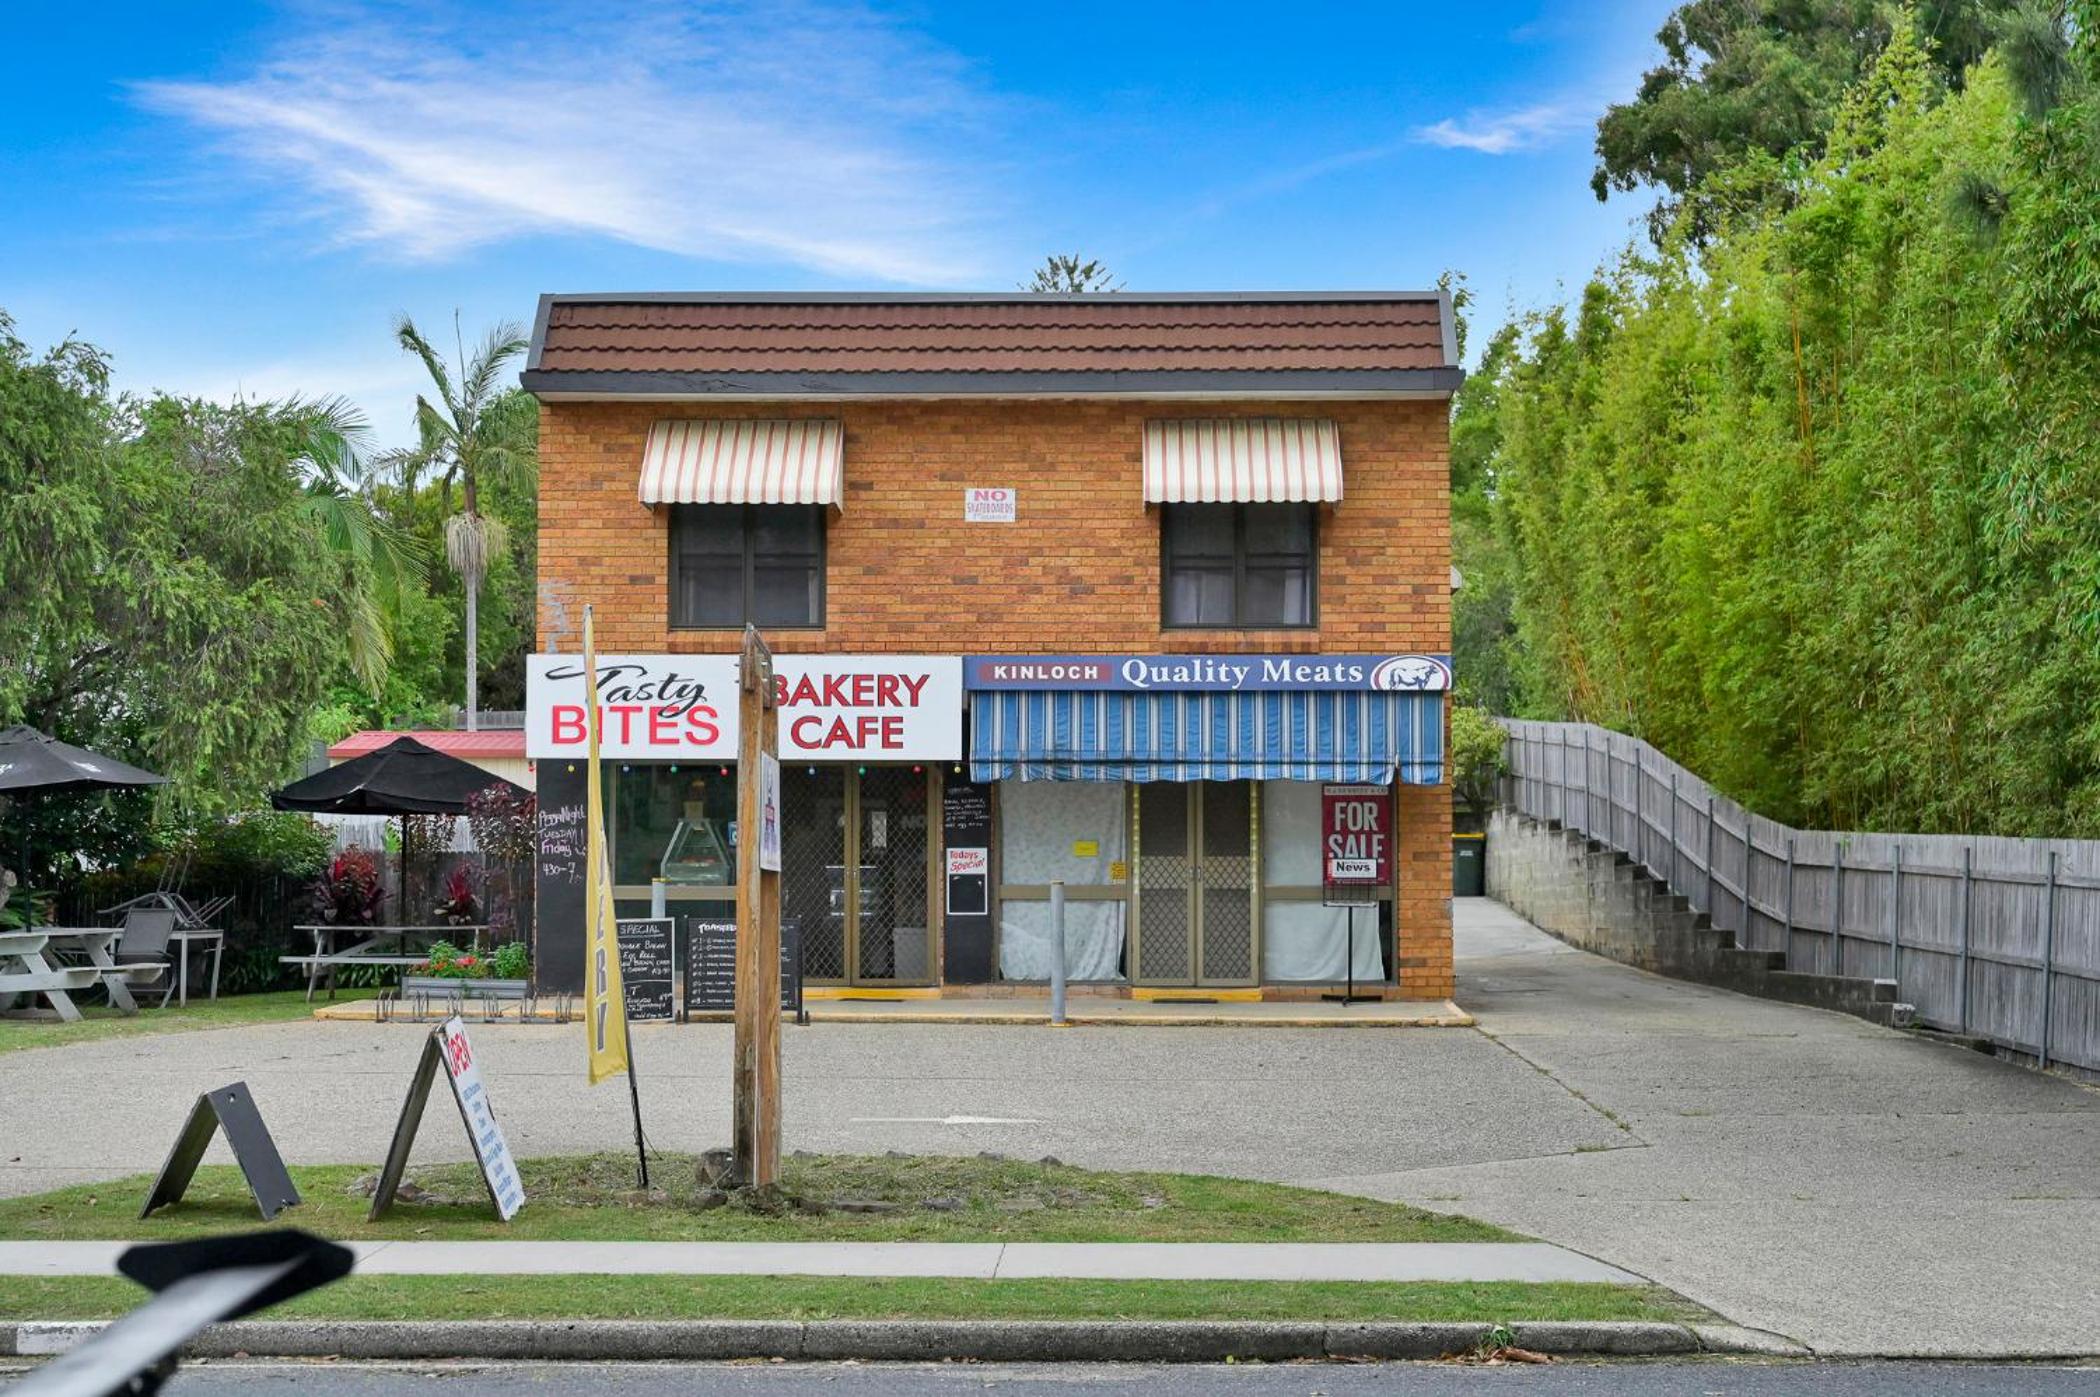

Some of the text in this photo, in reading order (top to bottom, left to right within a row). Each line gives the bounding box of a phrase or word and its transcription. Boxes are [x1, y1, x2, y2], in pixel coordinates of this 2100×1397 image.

[974, 490, 1008, 501] NO
[994, 658, 1363, 690] KINLOCH Quality Meats
[544, 664, 707, 719] Tasty
[551, 704, 720, 745] BITES
[791, 714, 904, 750] CAFE
[1334, 801, 1379, 831] FOR
[1327, 833, 1385, 864] SALE
[1336, 861, 1371, 872] News
